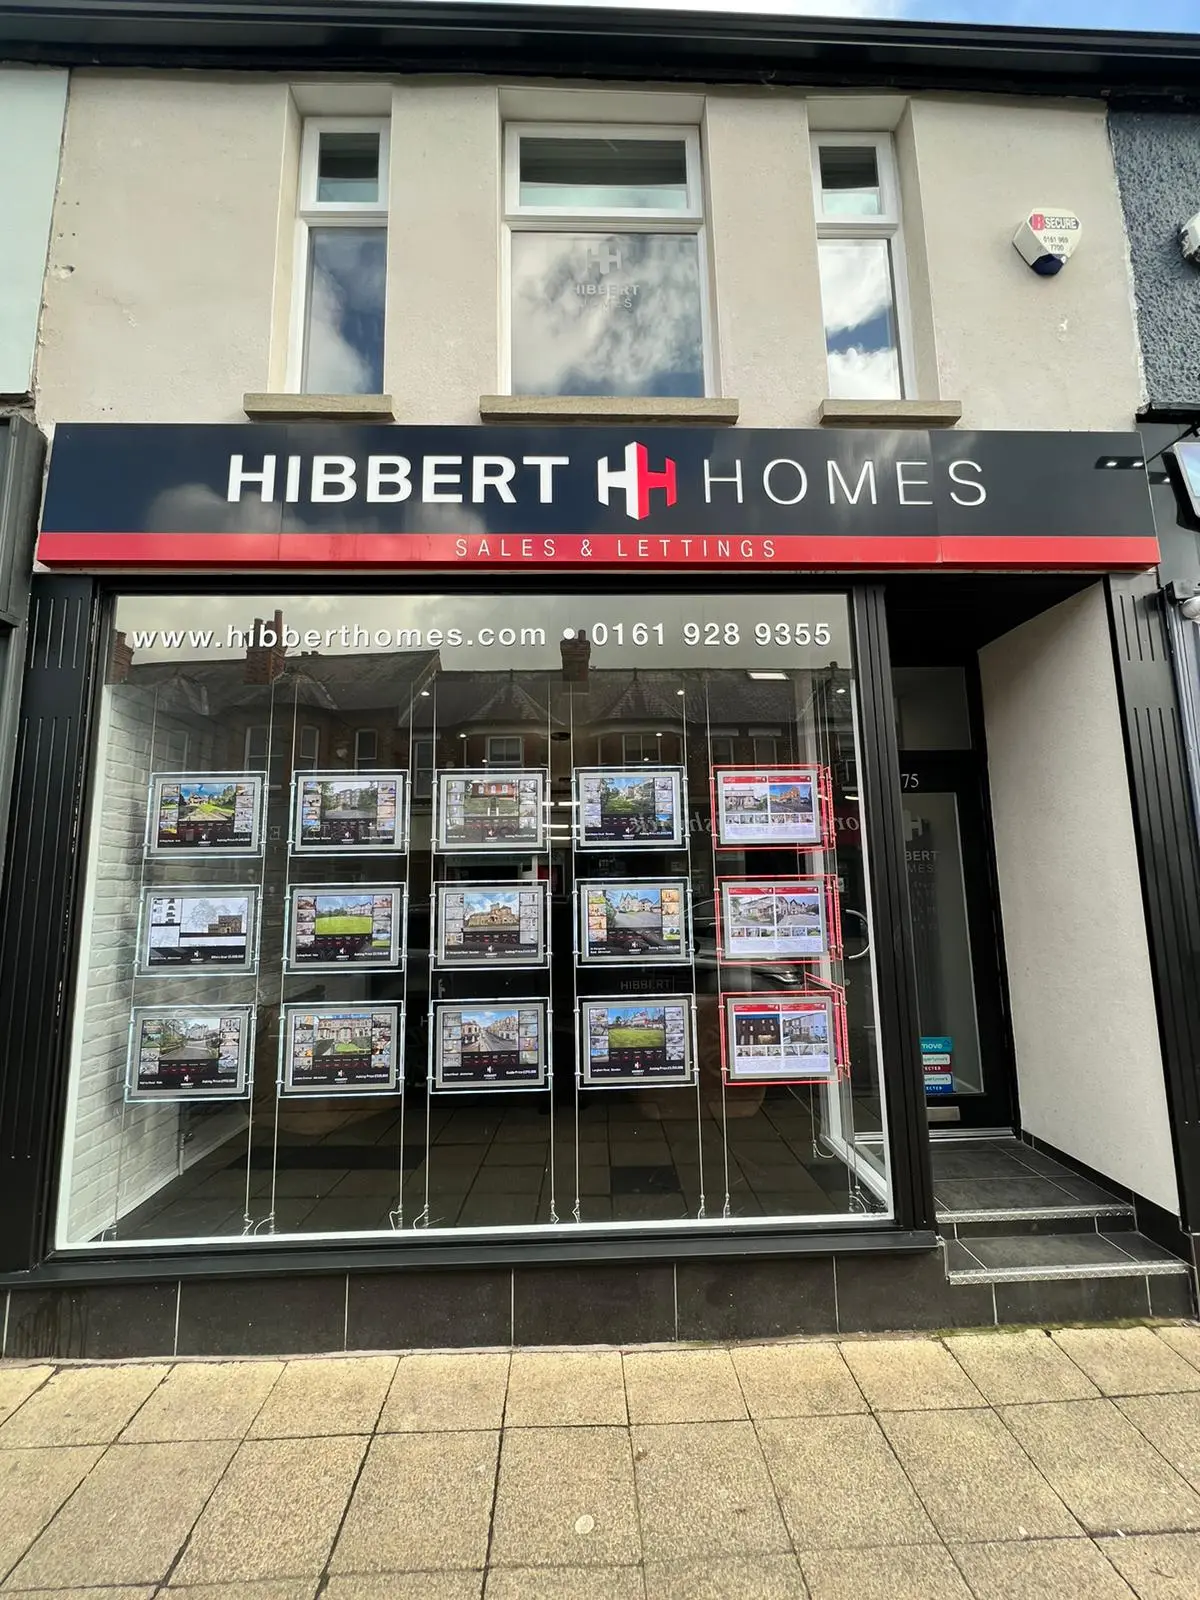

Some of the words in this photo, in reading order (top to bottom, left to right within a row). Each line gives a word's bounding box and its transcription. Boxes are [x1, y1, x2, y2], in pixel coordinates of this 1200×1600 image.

[1045, 217, 1077, 229] SECURE
[227, 454, 570, 504] HIBBERT
[703, 458, 988, 506] HOMES
[455, 538, 556, 557] SALES
[580, 539, 593, 557] &
[617, 539, 775, 557] LETTINGS
[132, 623, 547, 649] www.hibberthomes.com
[592, 622, 666, 646] 0161
[683, 622, 741, 646] 928
[754, 622, 832, 646] 9355
[901, 773, 919, 789] 75
[905, 850, 940, 861] BERT
[907, 863, 934, 873] MES
